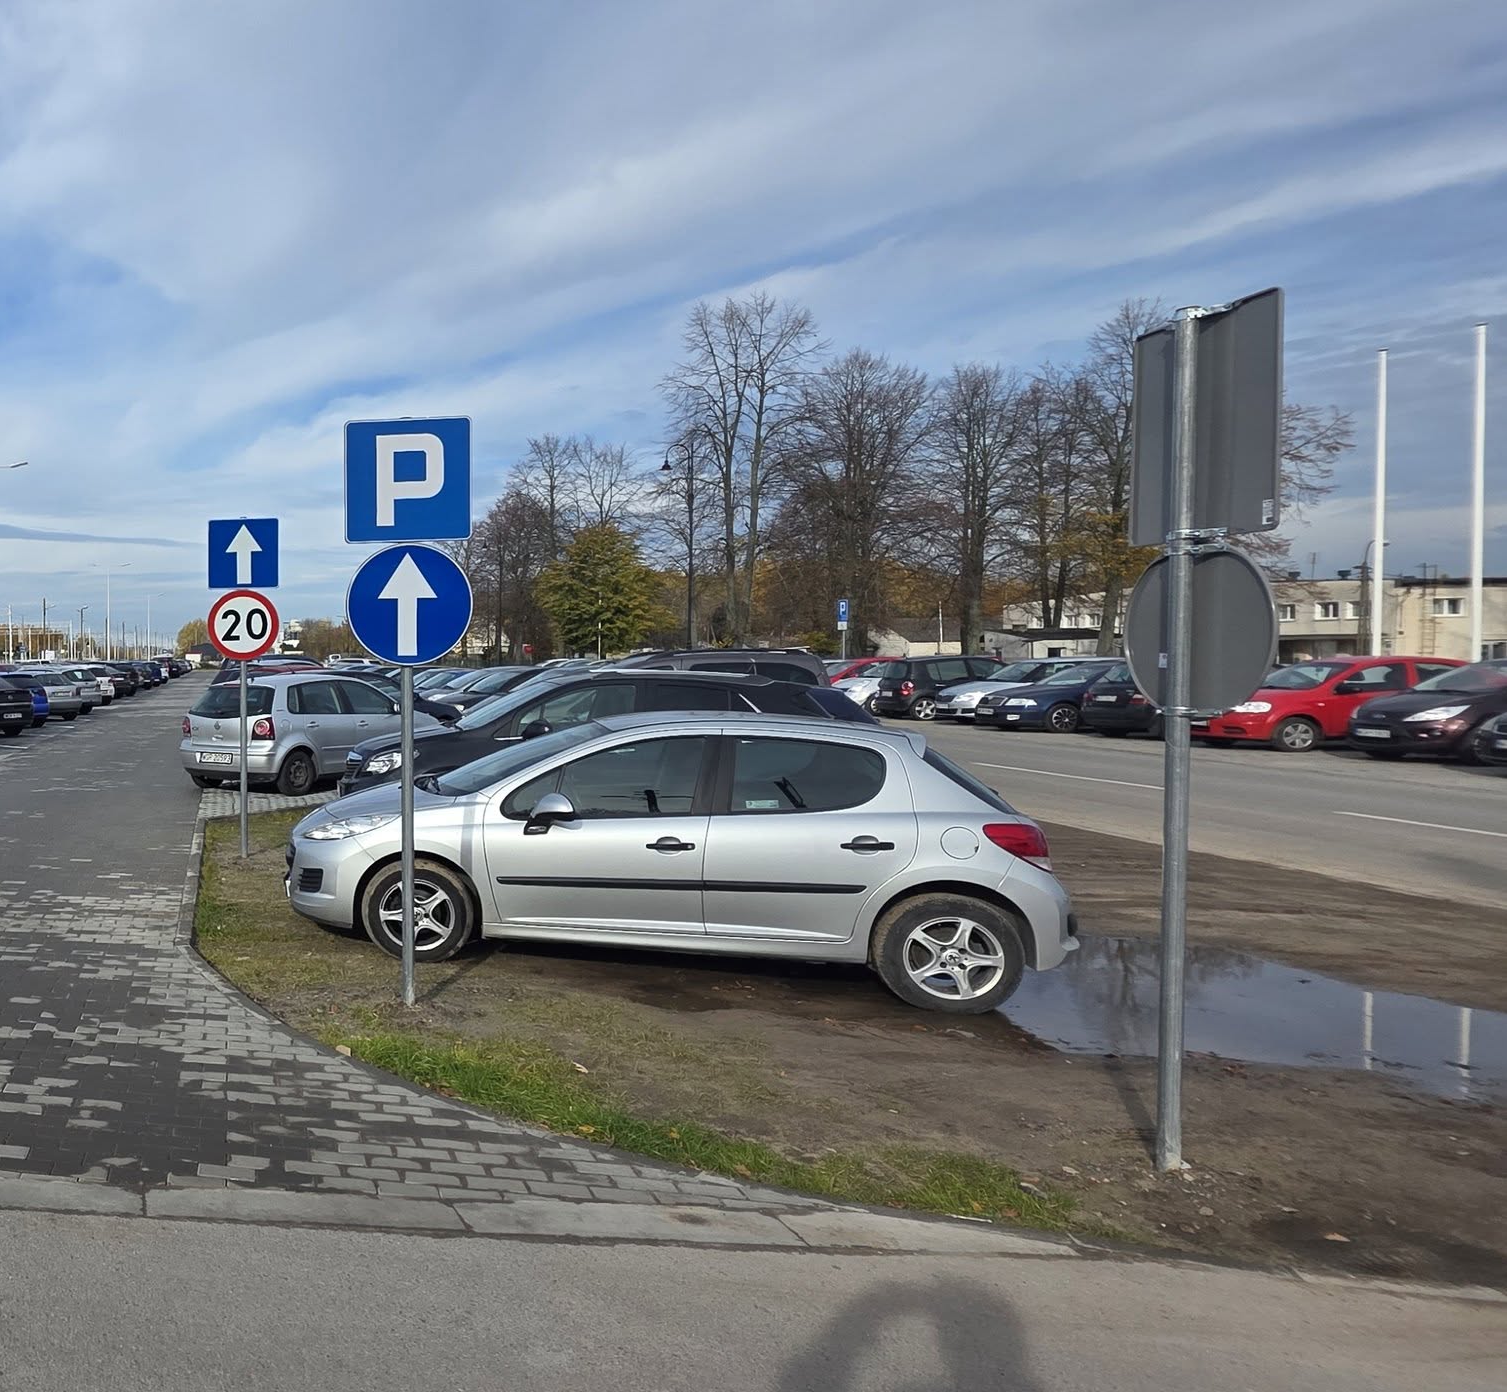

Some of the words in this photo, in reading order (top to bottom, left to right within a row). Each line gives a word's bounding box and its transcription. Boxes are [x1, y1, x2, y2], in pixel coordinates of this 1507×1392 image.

[376, 433, 444, 527] P
[221, 608, 268, 642] 20
[840, 602, 846, 615] P
